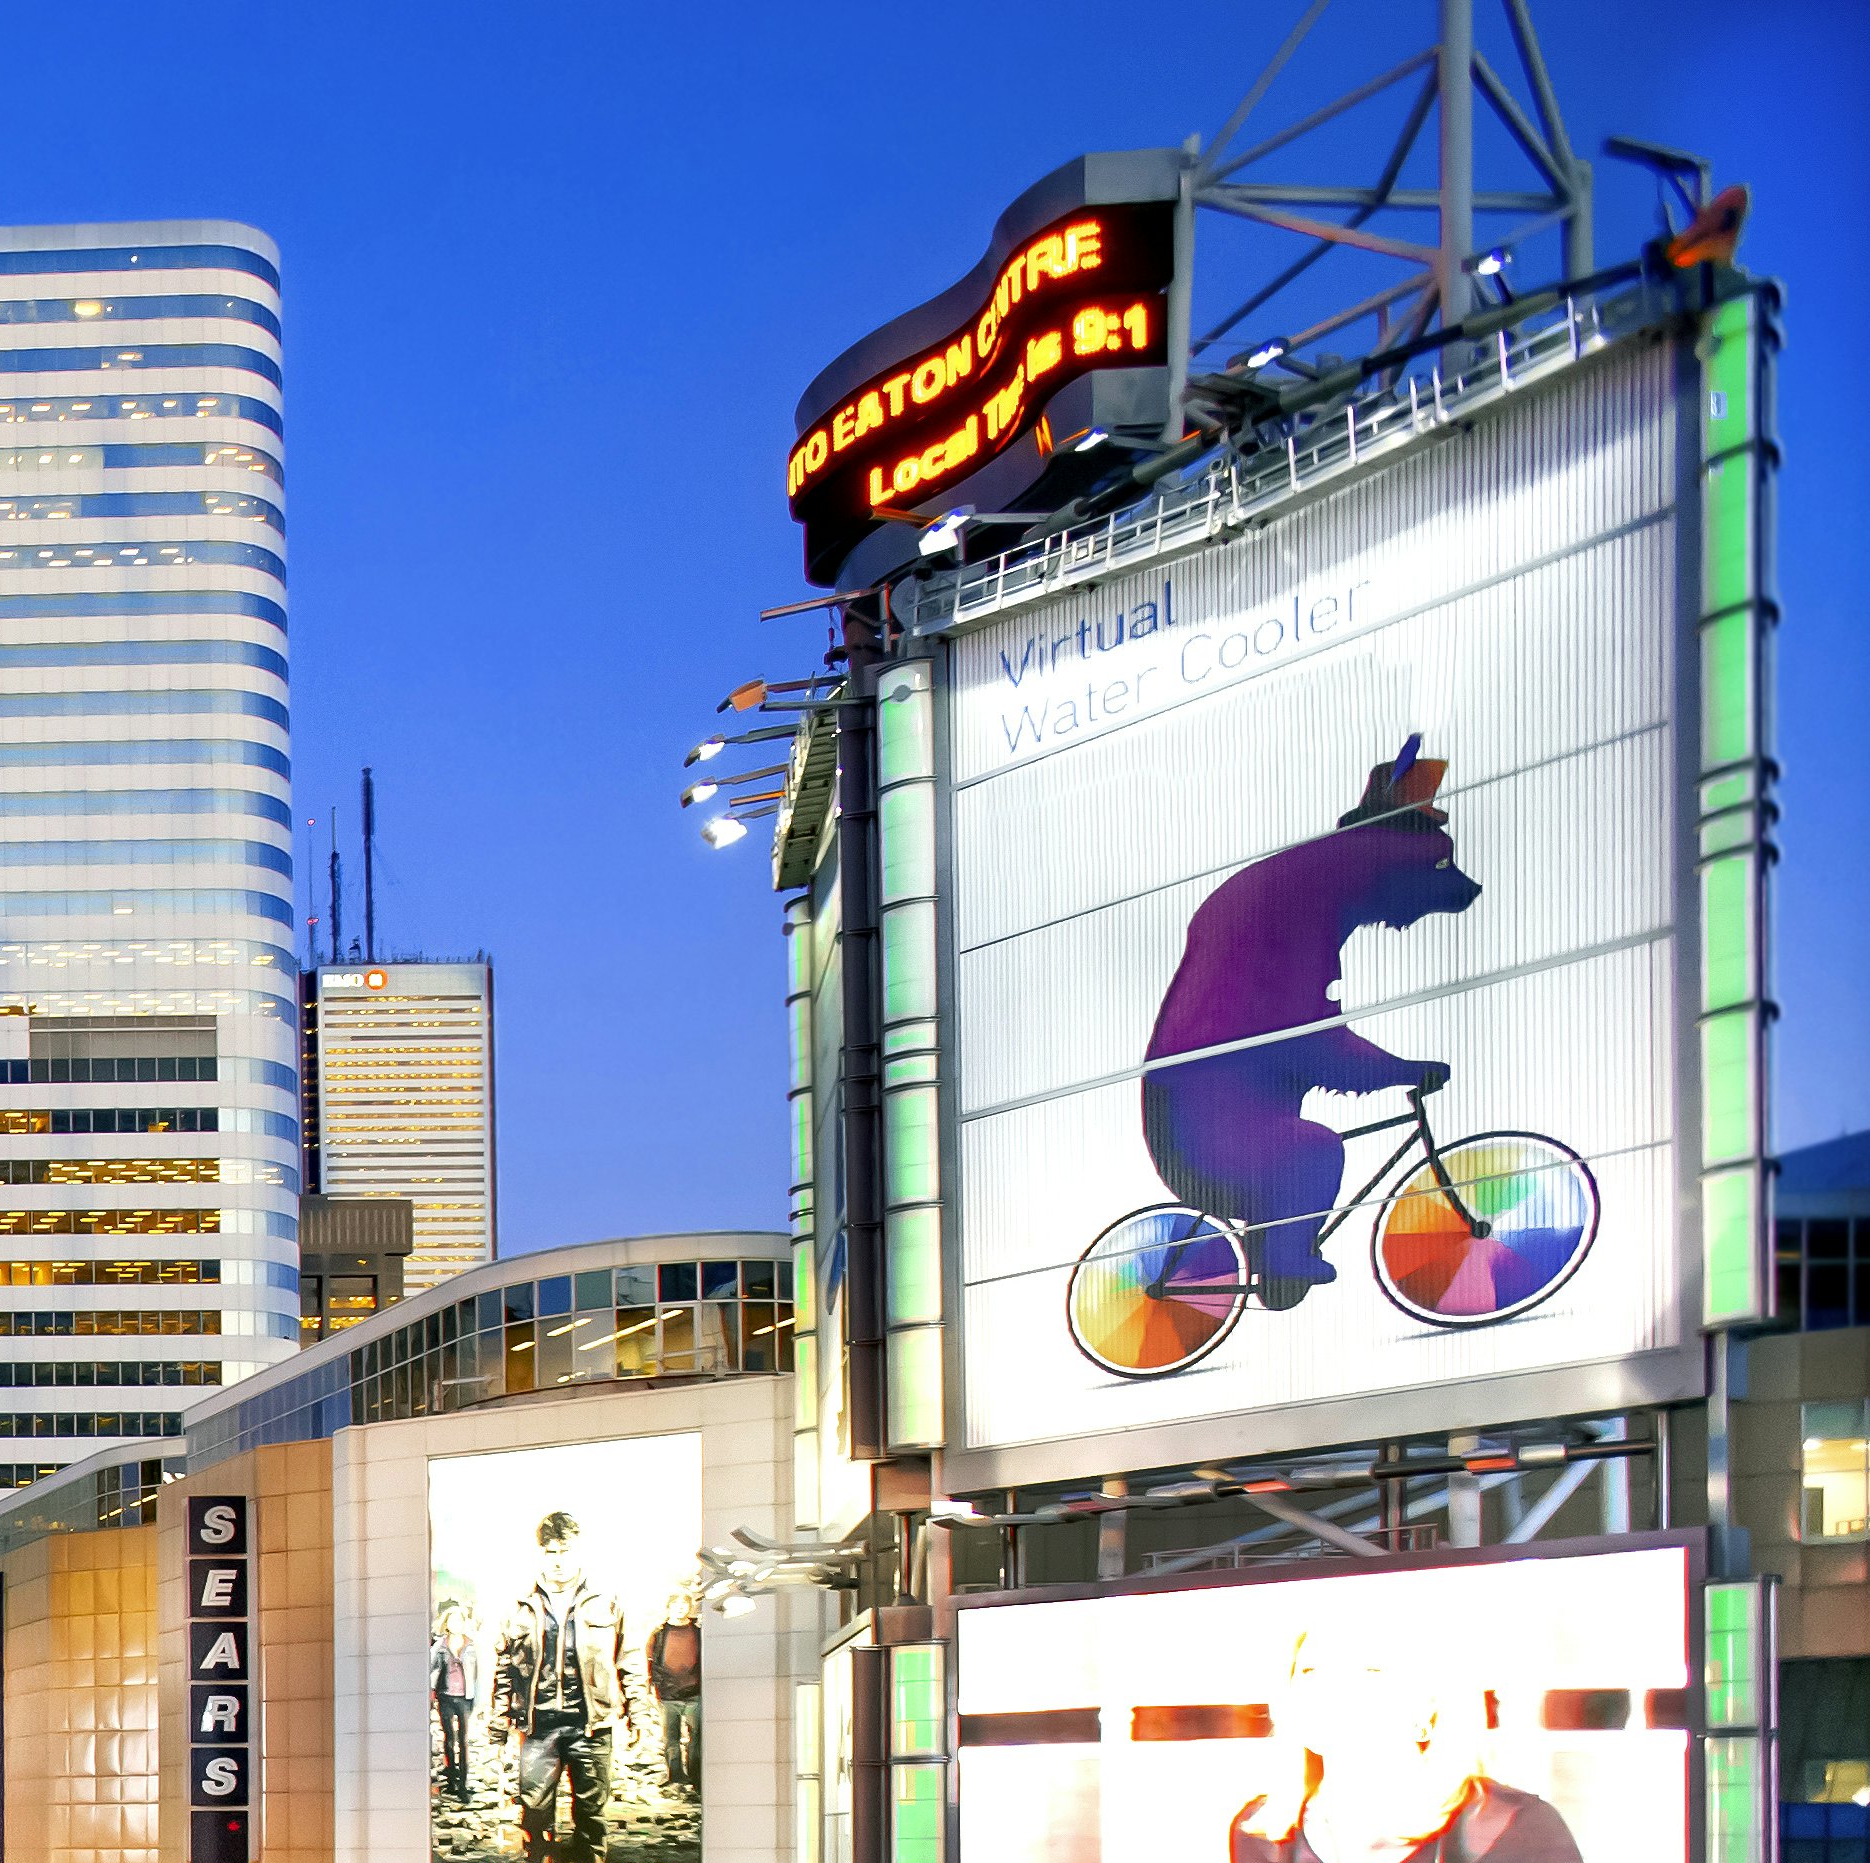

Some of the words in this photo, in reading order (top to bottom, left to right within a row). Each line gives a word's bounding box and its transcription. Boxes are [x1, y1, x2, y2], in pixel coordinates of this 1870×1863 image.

[833, 335, 973, 452] EATON
[870, 413, 979, 507] Local
[999, 580, 1177, 688] Virtual
[1001, 665, 1158, 754] Water
[1180, 579, 1372, 684] Cooler
[198, 1505, 241, 1797] SEARS
